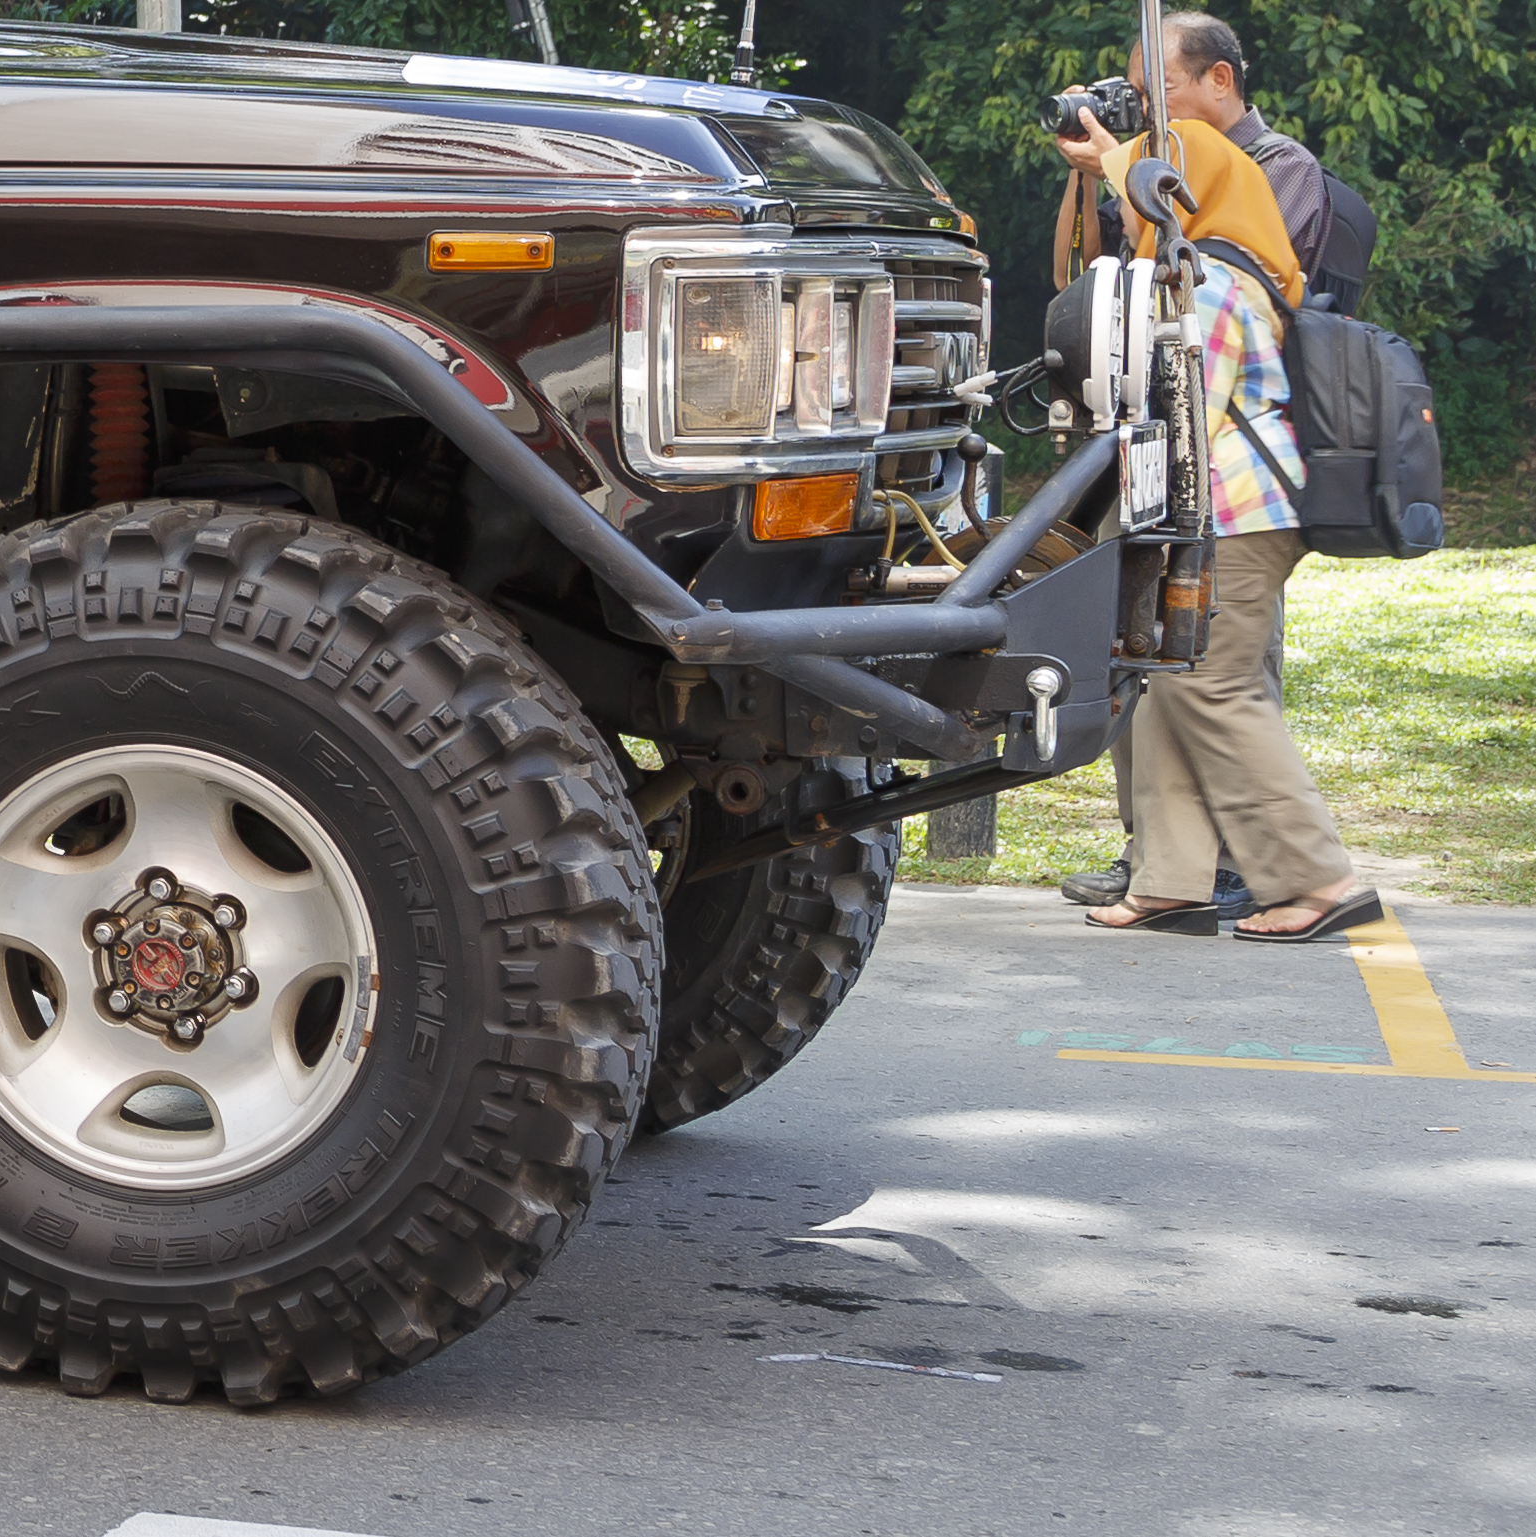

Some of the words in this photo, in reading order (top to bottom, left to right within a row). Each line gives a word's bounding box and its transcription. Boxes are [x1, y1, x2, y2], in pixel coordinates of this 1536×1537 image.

[298, 730, 447, 1075] EXTREME
[22, 1204, 80, 1250] 2
[107, 1109, 416, 1271] TREKKER
